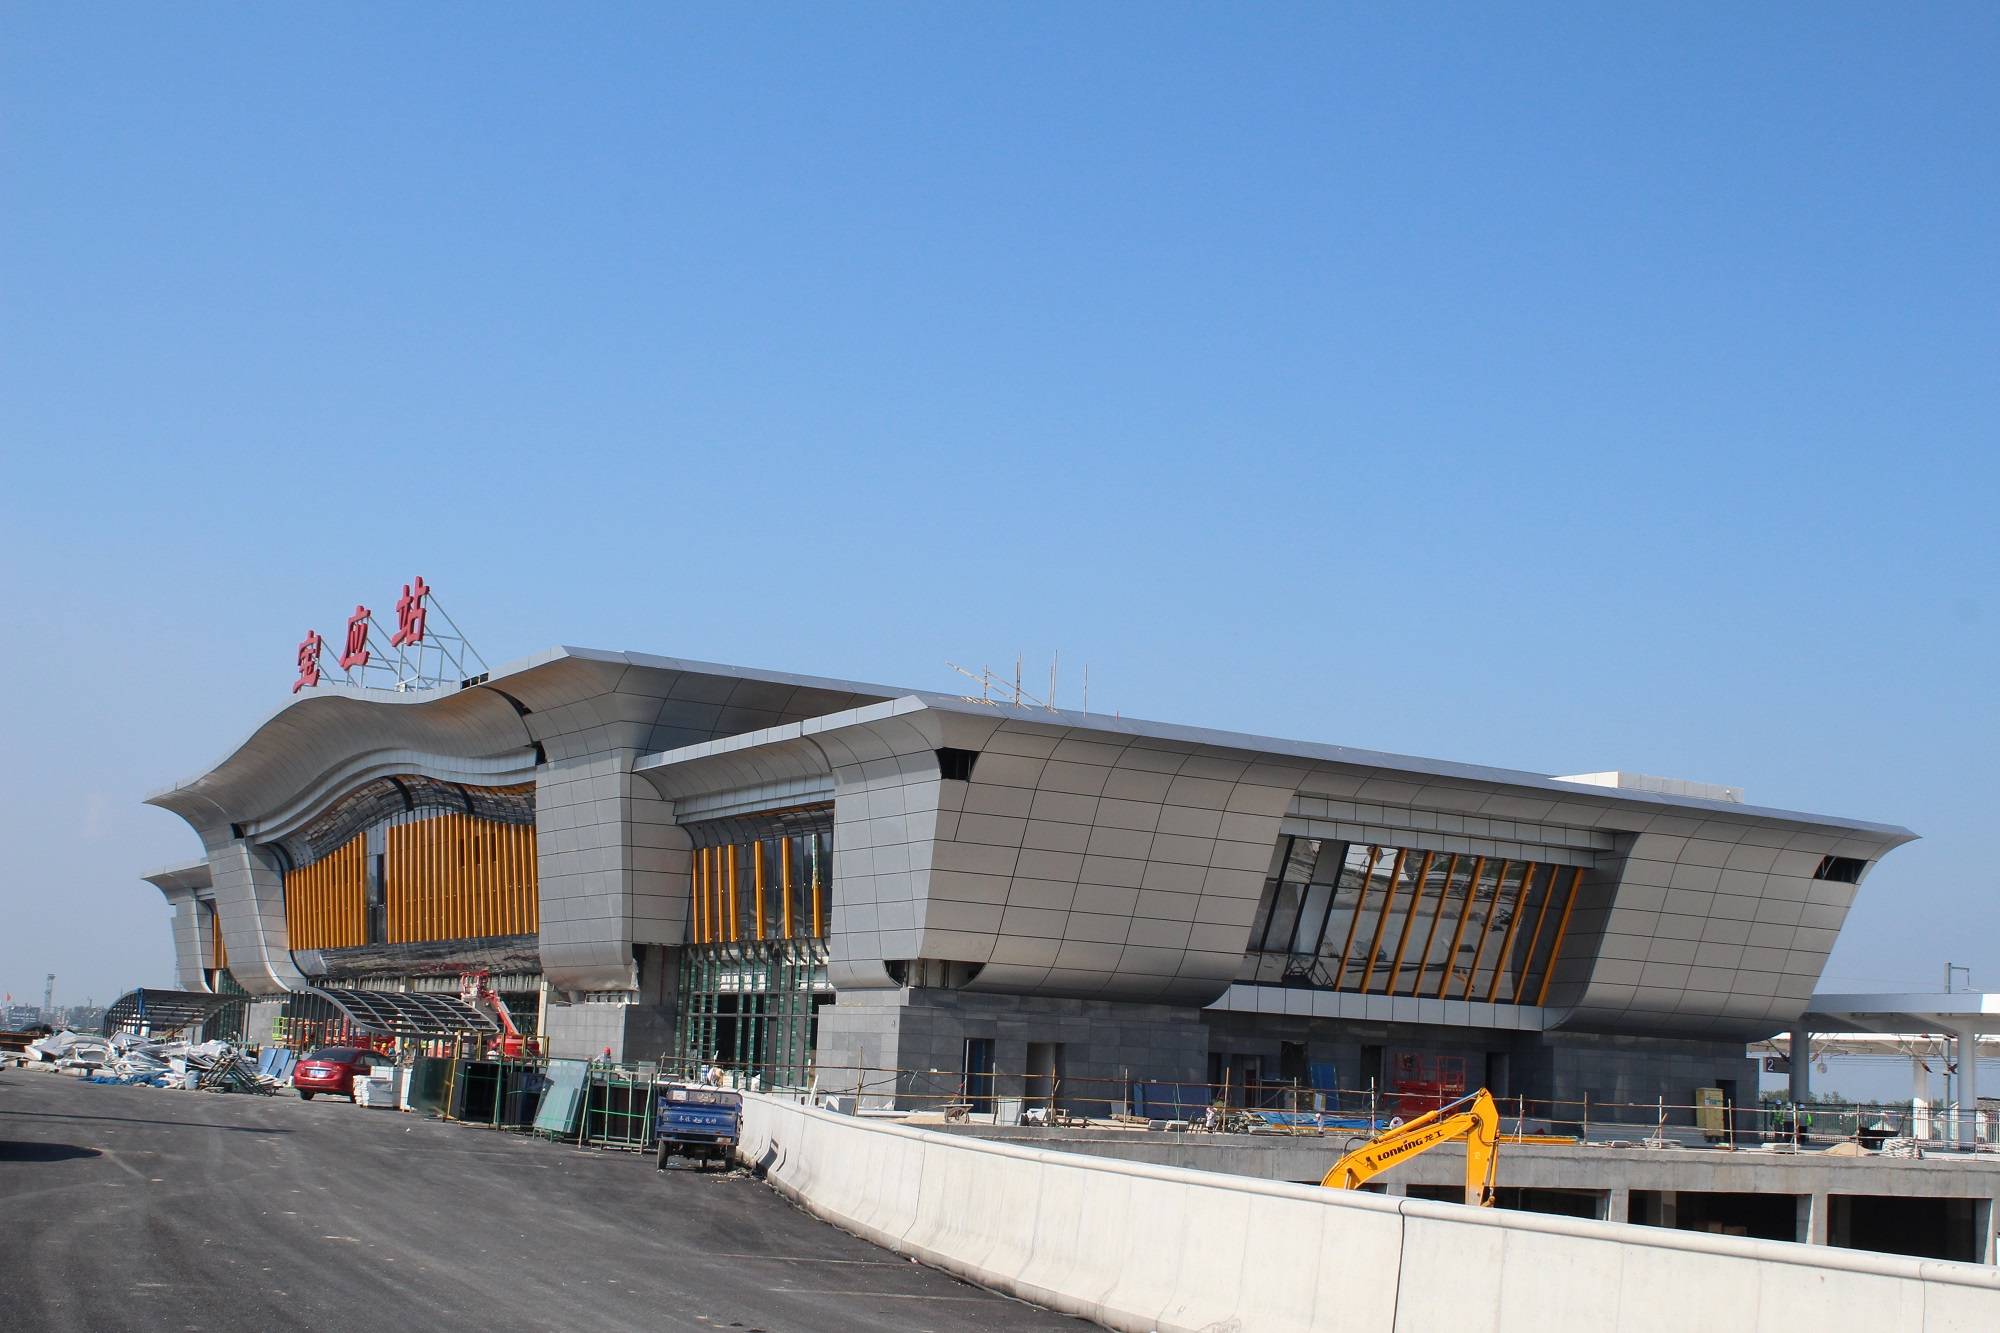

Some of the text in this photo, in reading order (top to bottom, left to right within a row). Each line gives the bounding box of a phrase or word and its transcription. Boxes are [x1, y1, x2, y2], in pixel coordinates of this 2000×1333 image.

[293, 576, 430, 694] 宝应站
[1767, 1059, 1774, 1071] 2
[1425, 1130, 1444, 1142] 龙工
